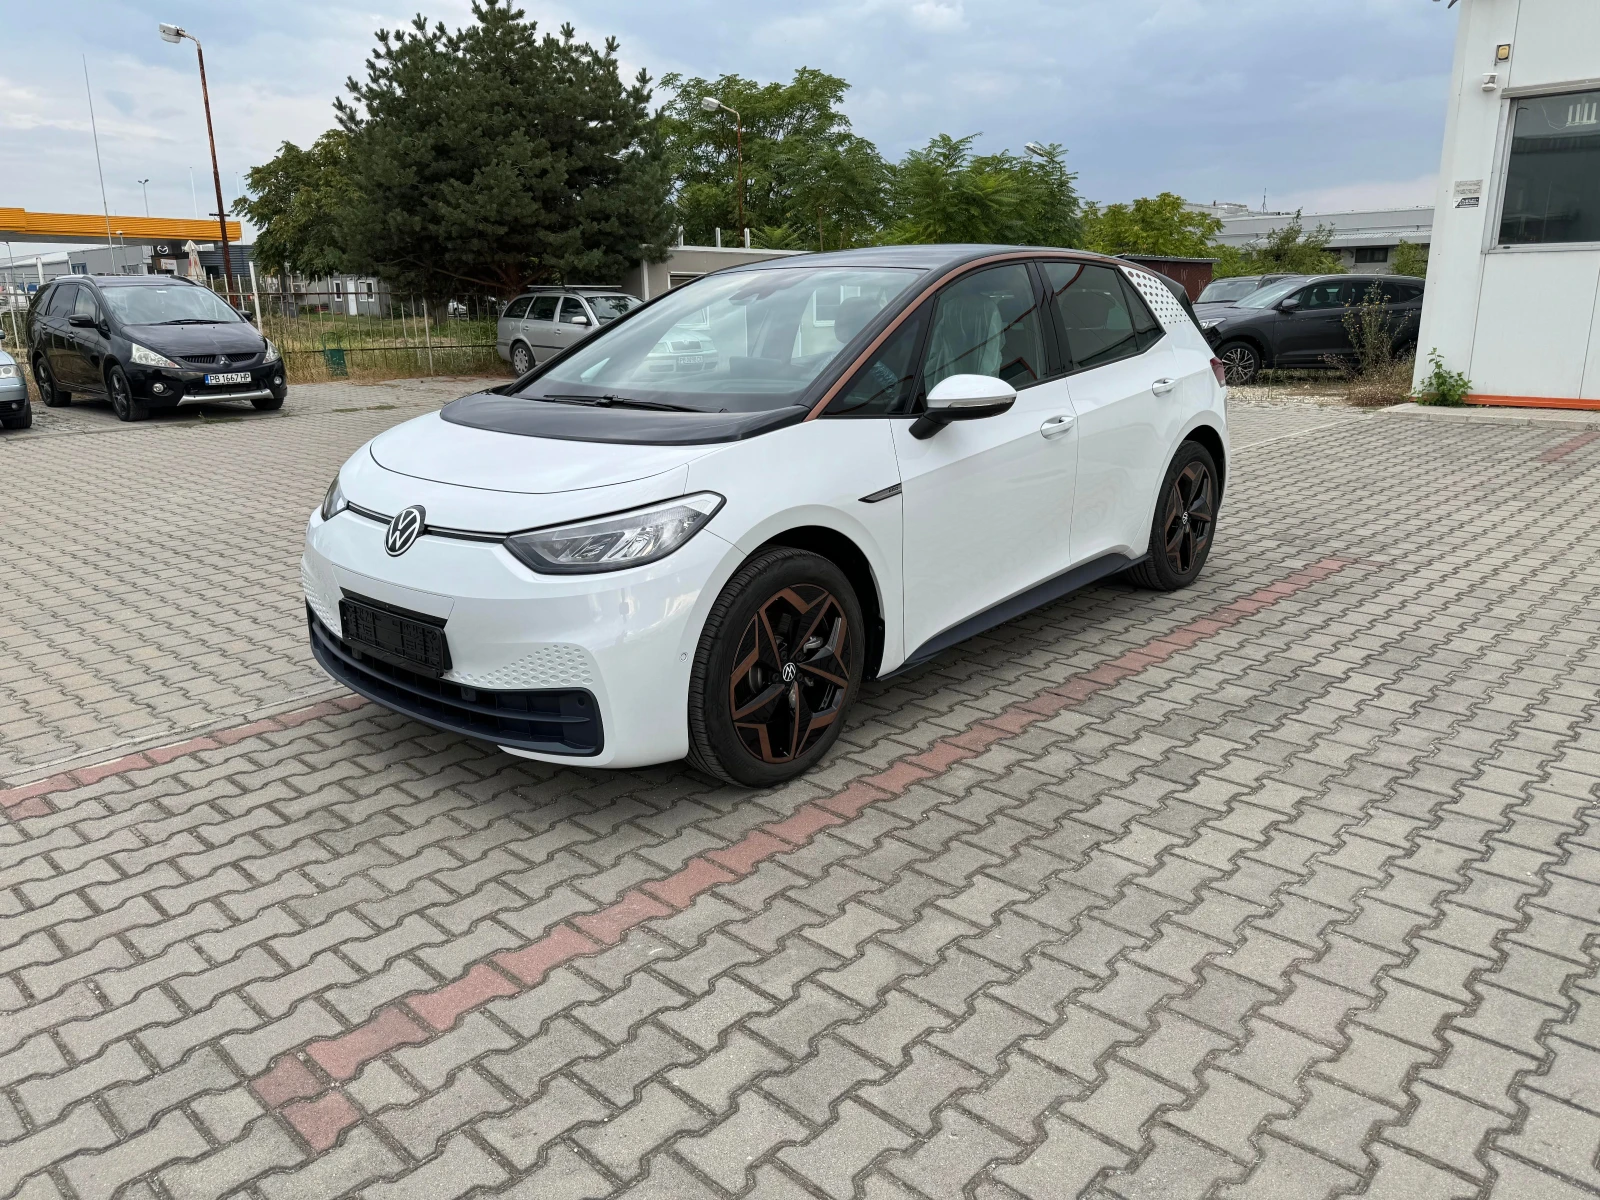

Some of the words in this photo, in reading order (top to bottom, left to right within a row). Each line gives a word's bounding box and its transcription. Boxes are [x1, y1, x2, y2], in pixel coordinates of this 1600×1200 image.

[209, 375, 221, 383] PB
[222, 374, 239, 382] 1667
[240, 373, 250, 381] HP
